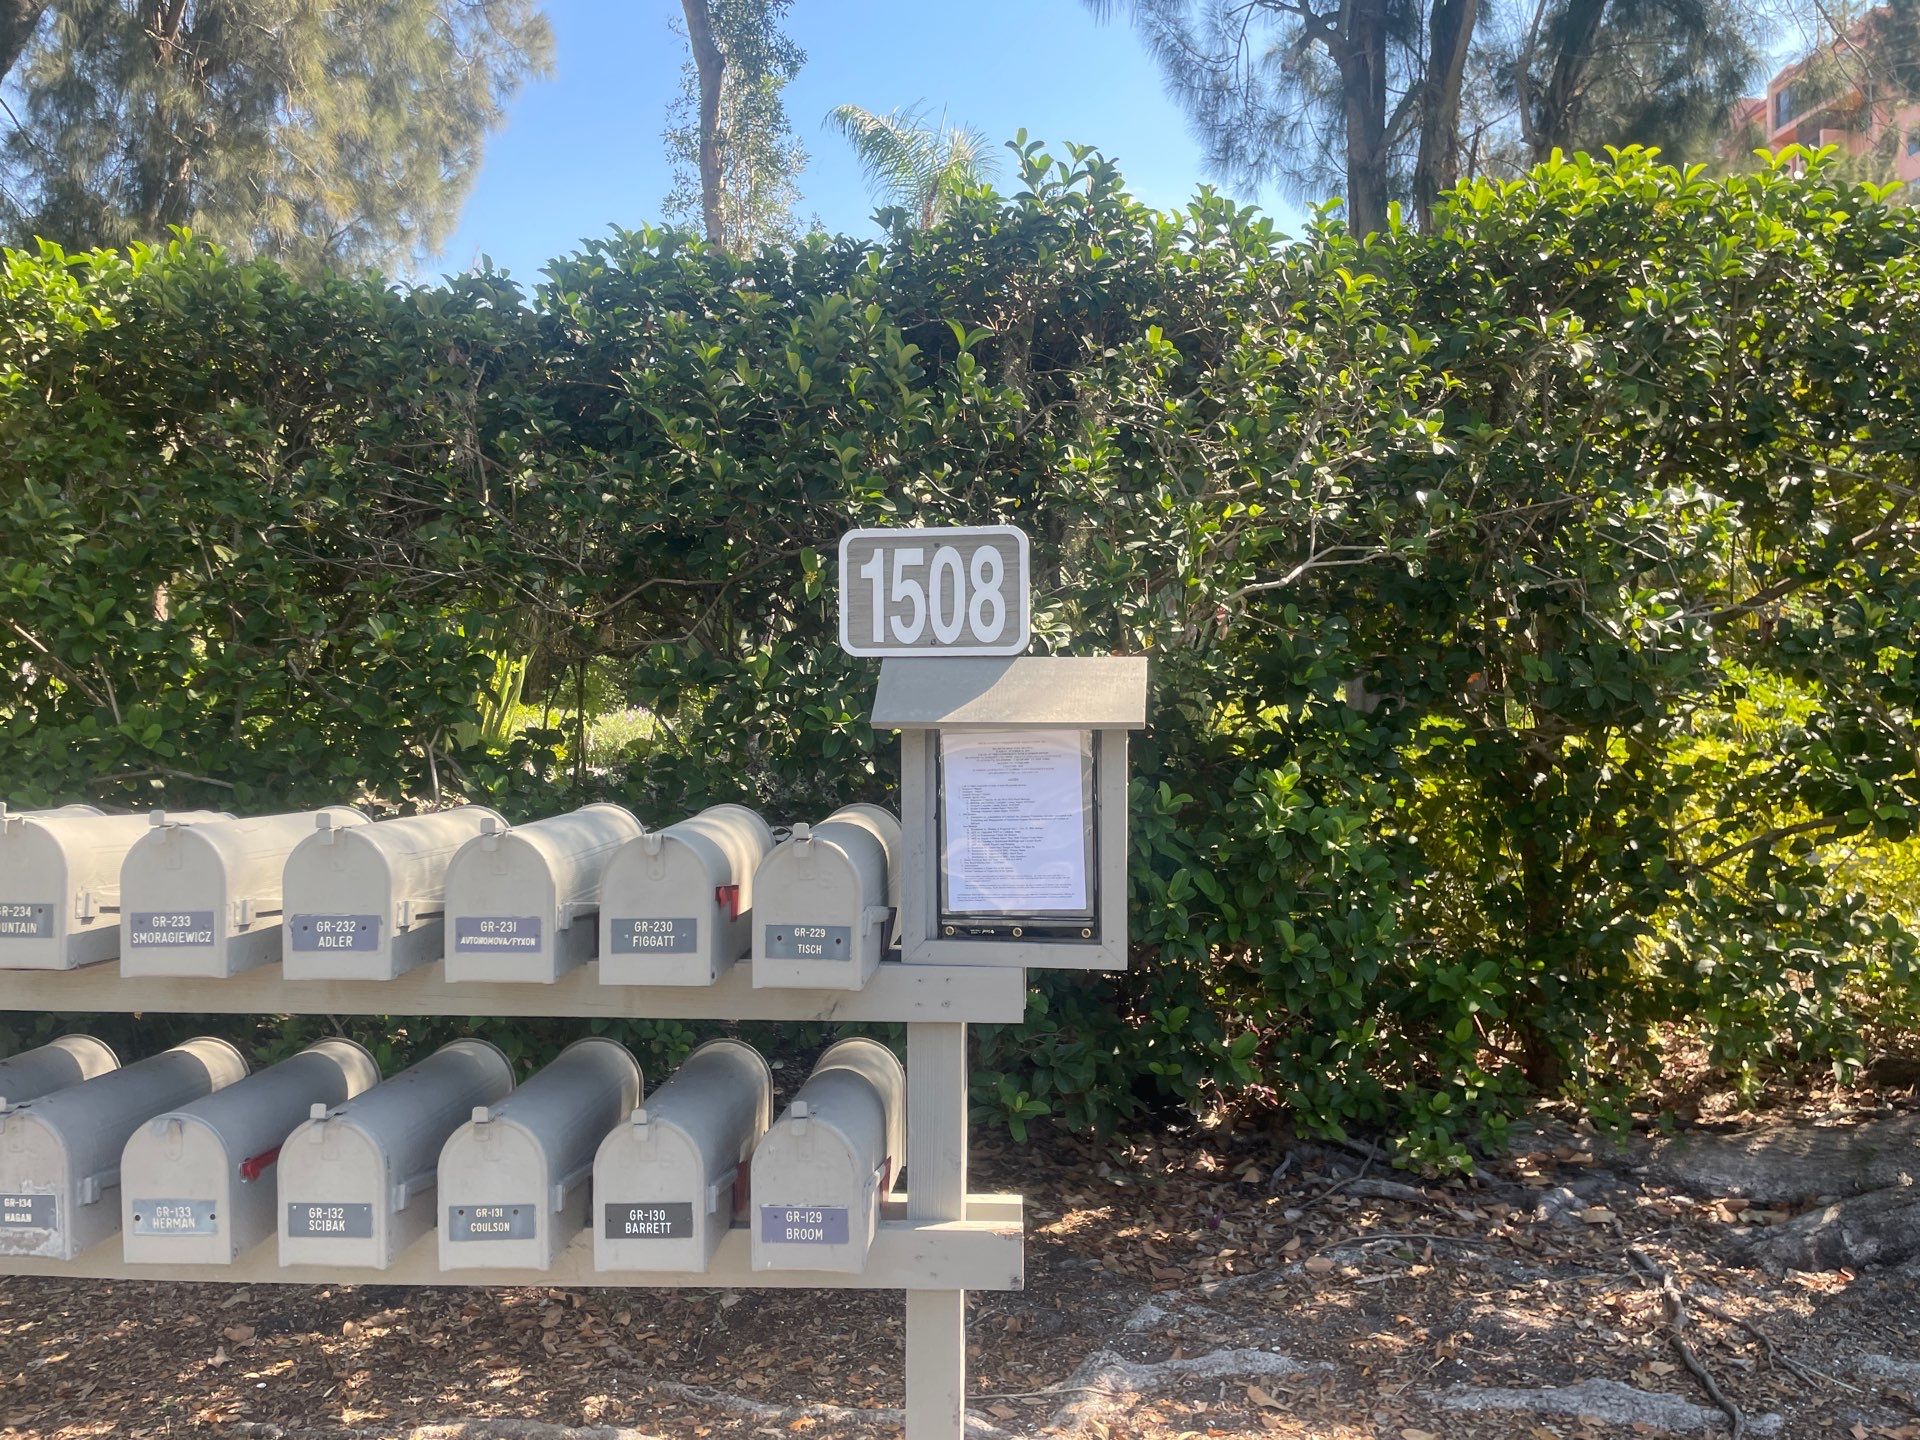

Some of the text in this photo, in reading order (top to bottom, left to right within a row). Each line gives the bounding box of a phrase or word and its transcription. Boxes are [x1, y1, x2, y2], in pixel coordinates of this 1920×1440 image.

[861, 545, 1006, 644] 1508
[0, 905, 31, 917] R-234
[152, 915, 191, 927] GR-233
[316, 920, 356, 933] GR-232
[480, 921, 517, 933] GR-231
[634, 921, 673, 932] GR-230
[0, 922, 37, 934] UNTAIN
[794, 927, 826, 938] GR-229
[132, 931, 212, 944] SMORAGIEWICZ
[318, 936, 353, 948] ADLER
[632, 935, 675, 947] FIGGATT
[797, 944, 822, 955] TISCH
[4, 1198, 32, 1208] GR-134
[156, 1206, 192, 1218] GR-133
[308, 1207, 344, 1219] GR-132
[475, 1208, 503, 1218] GR-131
[629, 1209, 666, 1221] GR-130
[785, 1211, 823, 1223] GR-129
[153, 1218, 195, 1229] HERMAN
[308, 1220, 346, 1231] SCIBAK
[470, 1222, 510, 1232] COULSON
[625, 1222, 672, 1234] BARRETT
[786, 1228, 823, 1240] BROOM
